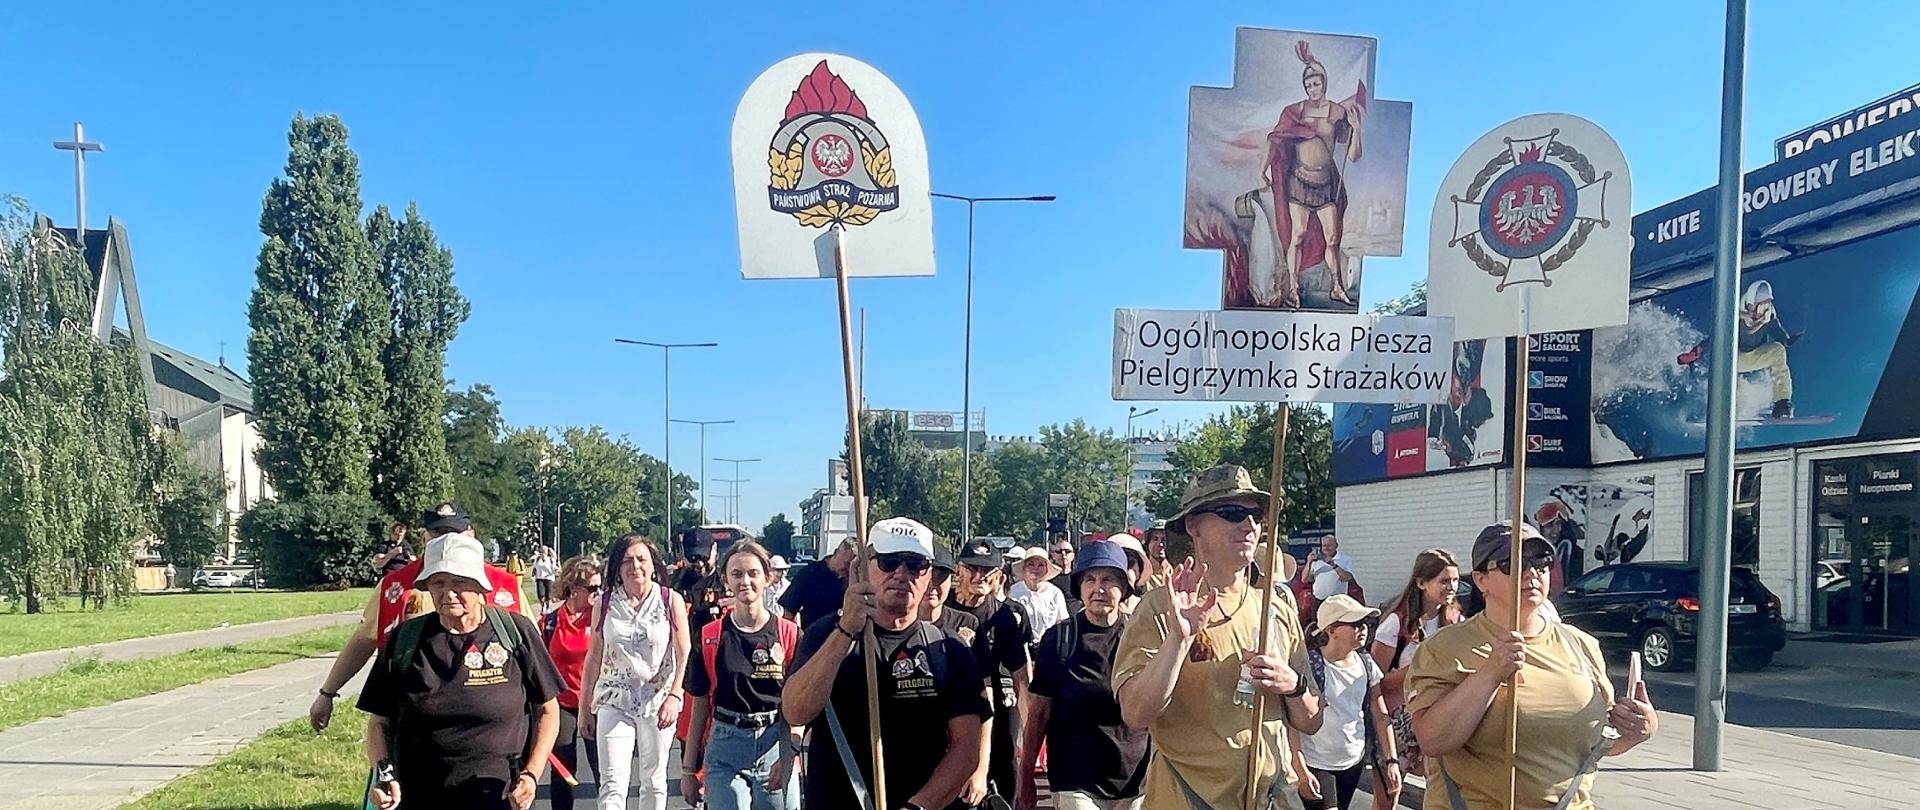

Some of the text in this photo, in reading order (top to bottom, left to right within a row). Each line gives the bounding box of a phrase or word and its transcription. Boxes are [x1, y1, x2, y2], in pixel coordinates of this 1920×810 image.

[773, 183, 895, 208] PAŃSTWOWA STRAŻ POŻARNA
[1657, 210, 1701, 243] KITE
[1742, 159, 1840, 214] ROWERY
[1138, 320, 1432, 357] Ogólnopolska Piesza
[1542, 333, 1581, 344] SPORT
[1542, 343, 1581, 352] SALON.PL
[1120, 358, 1447, 395] Pielgrzymka Strażaków
[1872, 469, 1899, 480] Pianki
[1859, 483, 1913, 494] Neoprenowe
[891, 527, 917, 536] 1916
